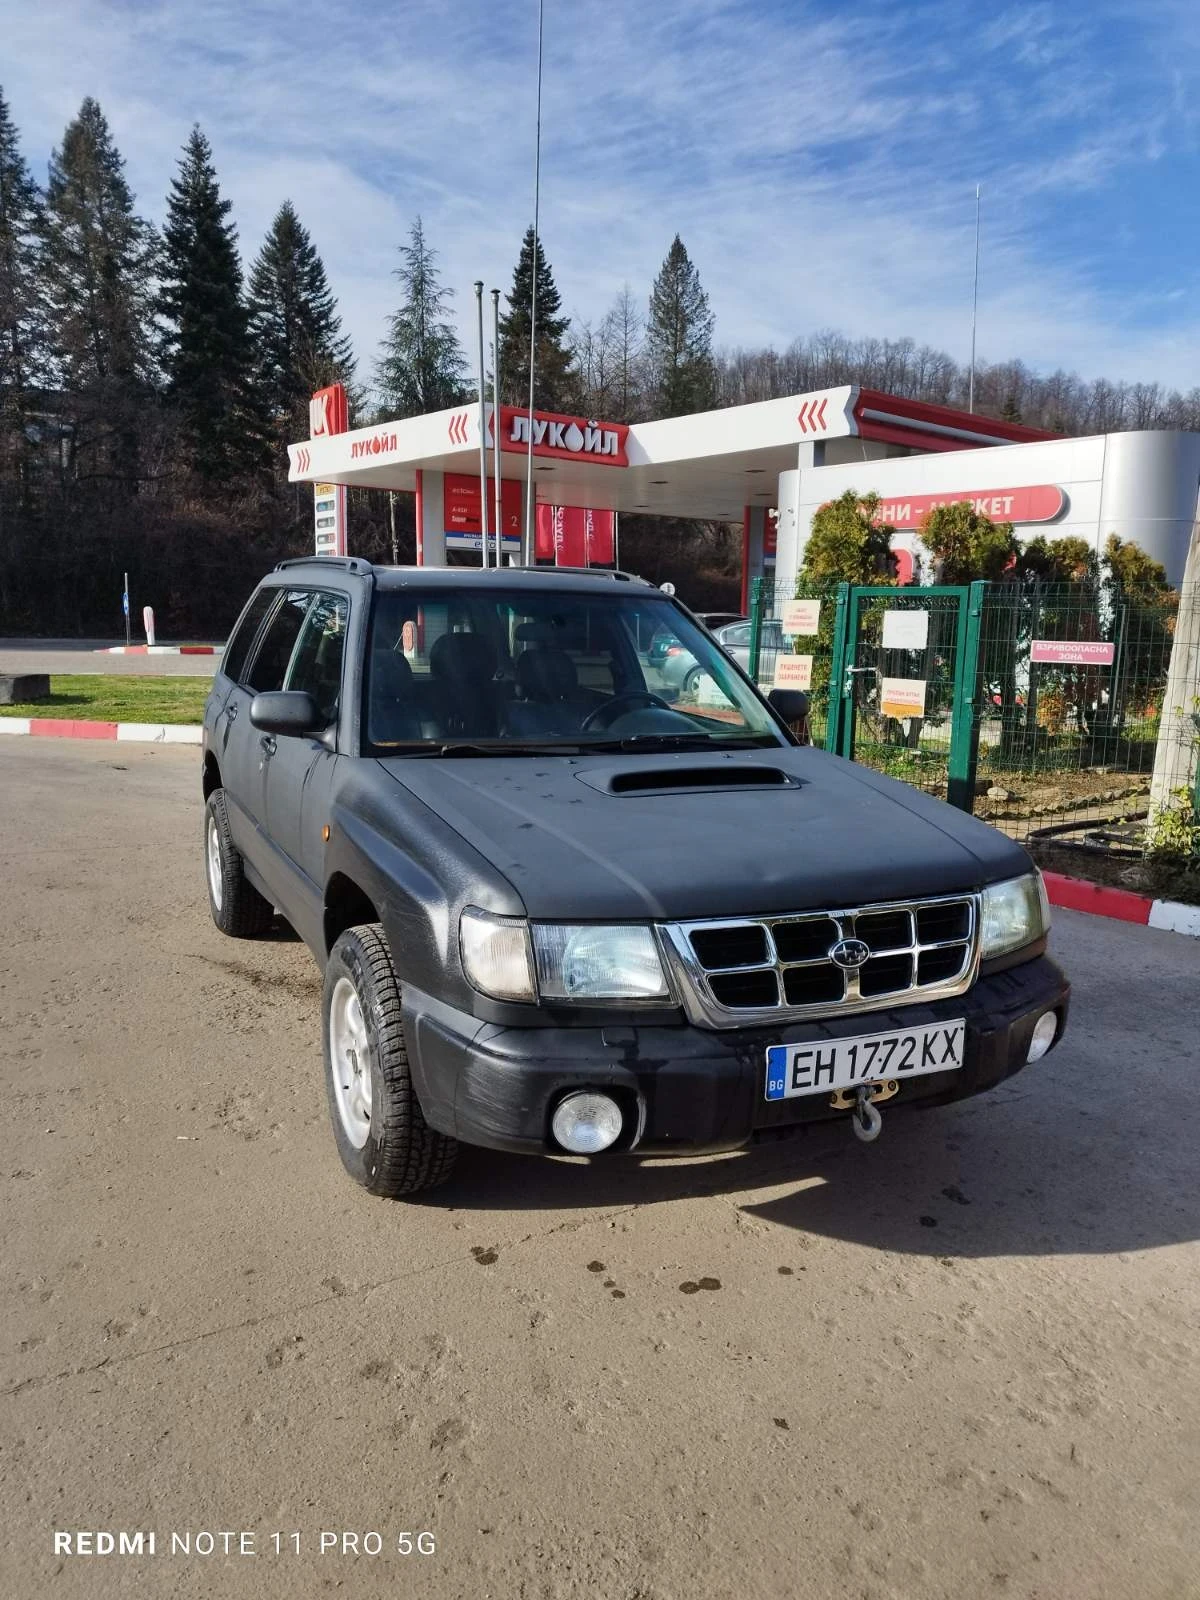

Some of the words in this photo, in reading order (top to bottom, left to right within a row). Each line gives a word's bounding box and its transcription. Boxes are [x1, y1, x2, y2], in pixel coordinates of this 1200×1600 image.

[510, 415, 619, 456] ЛУКОЙЛ
[351, 432, 397, 459] ЛУКОЙЛ
[511, 515, 518, 527] 2
[1058, 653, 1084, 661] ЗОНА
[791, 1048, 837, 1090] EH
[769, 1080, 784, 1092] BG
